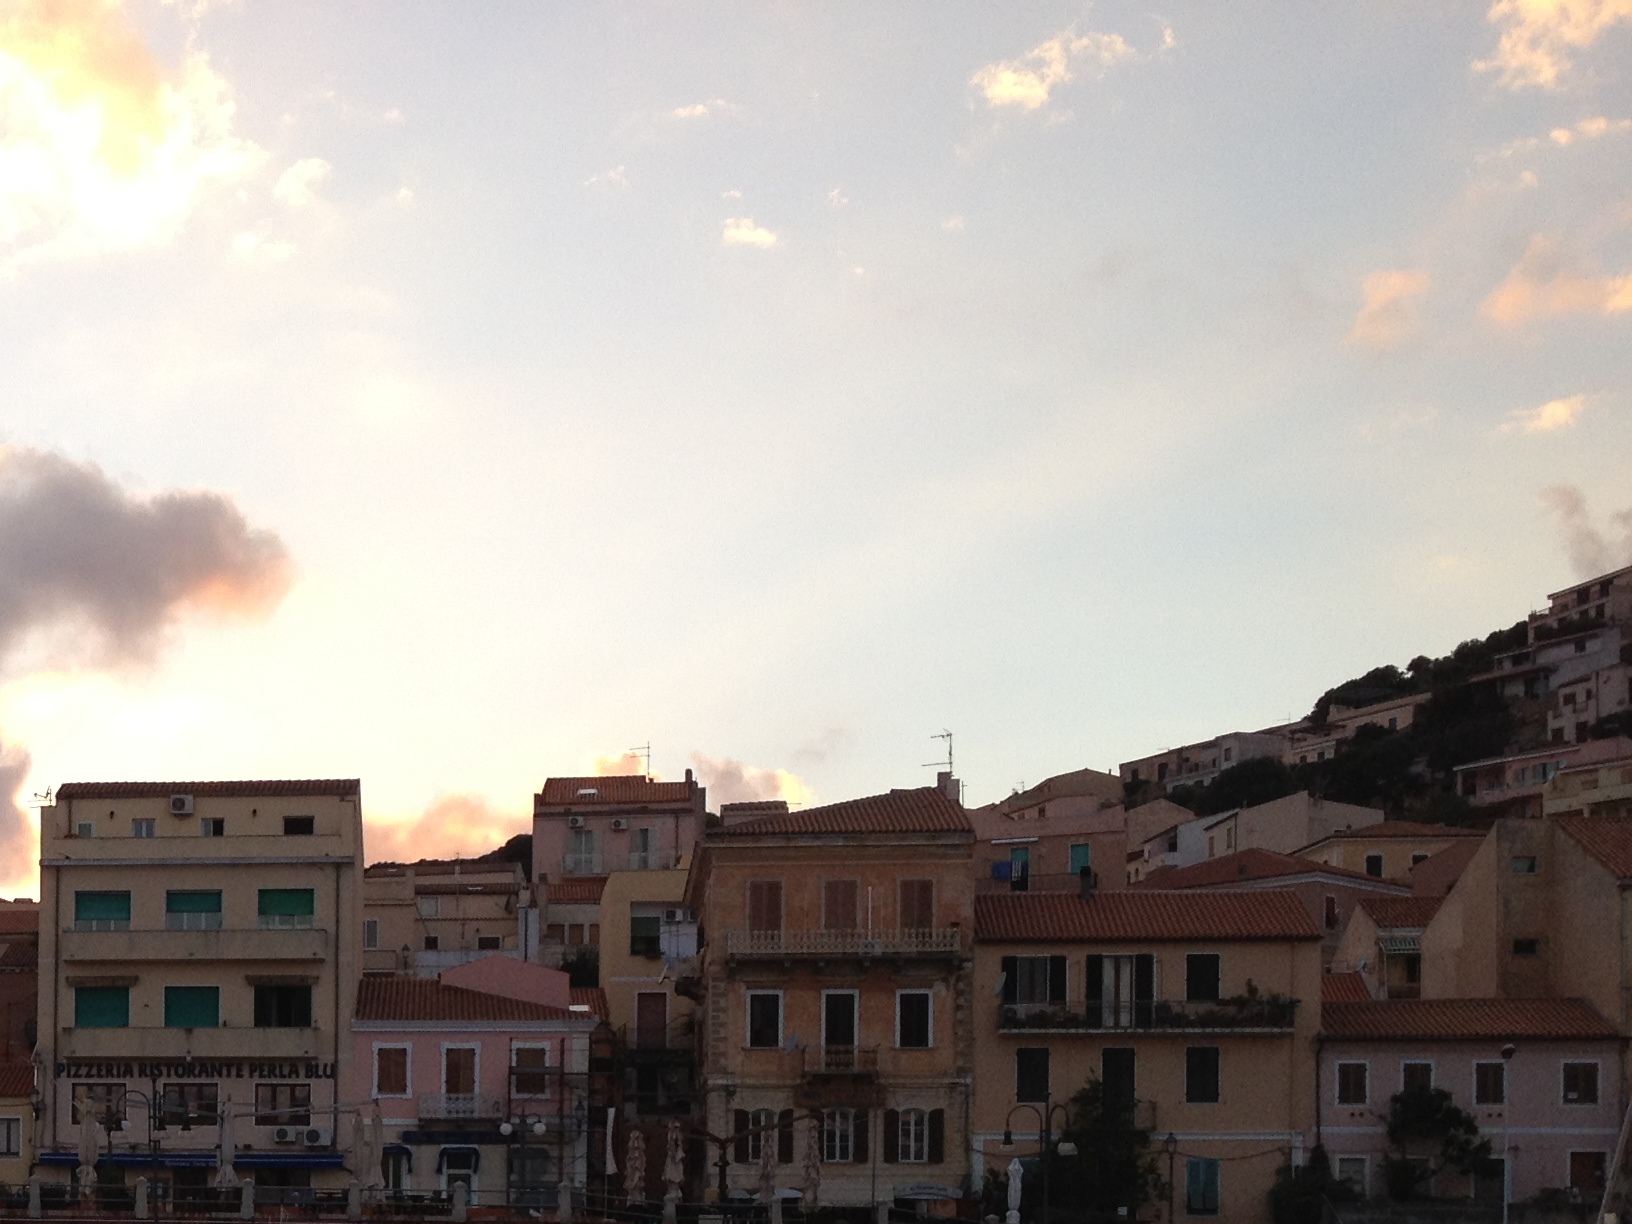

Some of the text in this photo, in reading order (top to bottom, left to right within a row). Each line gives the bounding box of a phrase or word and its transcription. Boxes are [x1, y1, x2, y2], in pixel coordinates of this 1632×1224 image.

[56, 1062, 337, 1079] PIZZERIA RISTORANTE PERLA BLU
